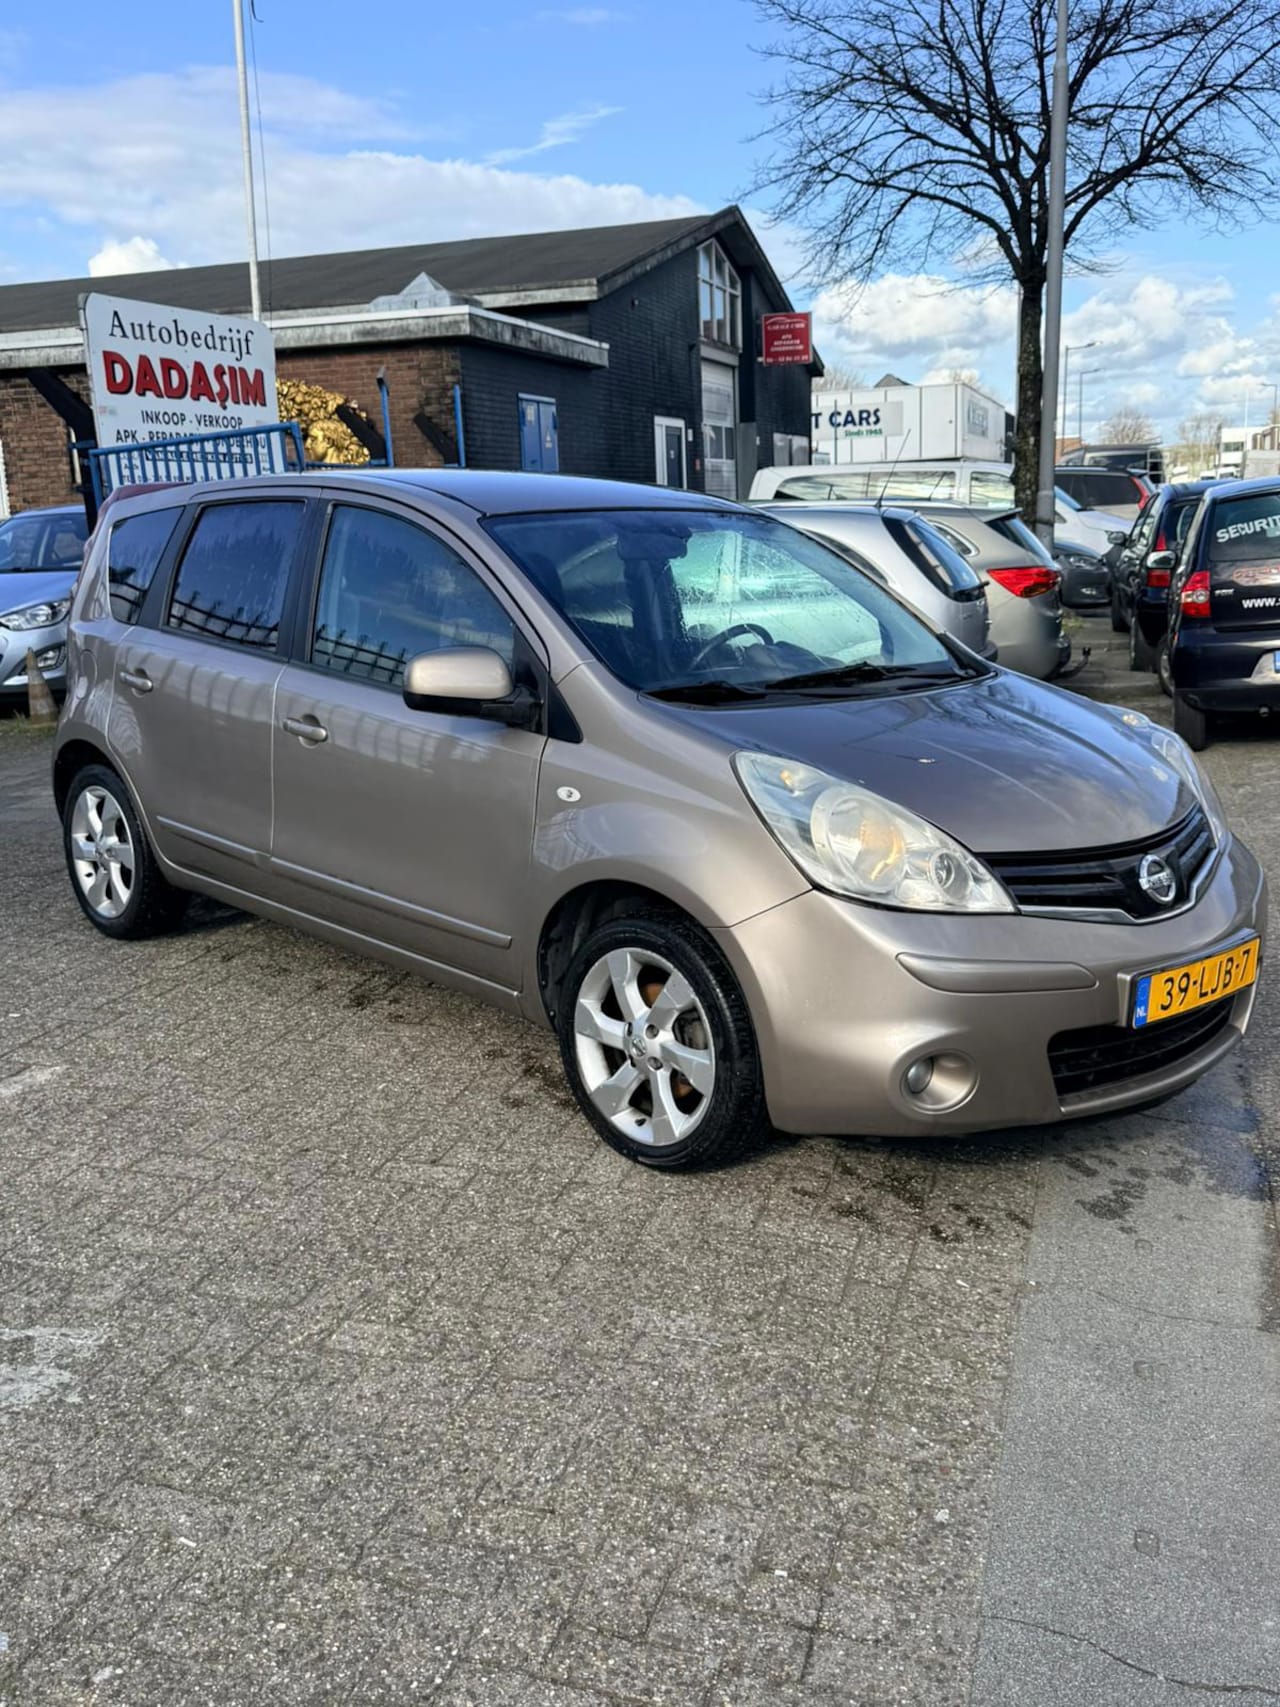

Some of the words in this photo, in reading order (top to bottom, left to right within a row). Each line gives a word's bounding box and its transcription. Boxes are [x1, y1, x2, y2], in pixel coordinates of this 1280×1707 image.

[108, 310, 254, 362] Autobedrijf
[141, 410, 187, 426] INKOOP
[195, 414, 243, 430] VERKOOP
[828, 408, 881, 428] CARS
[115, 429, 138, 444] APK
[1160, 948, 1251, 1012] 39-LJB-7
[1136, 1006, 1146, 1018] NL
